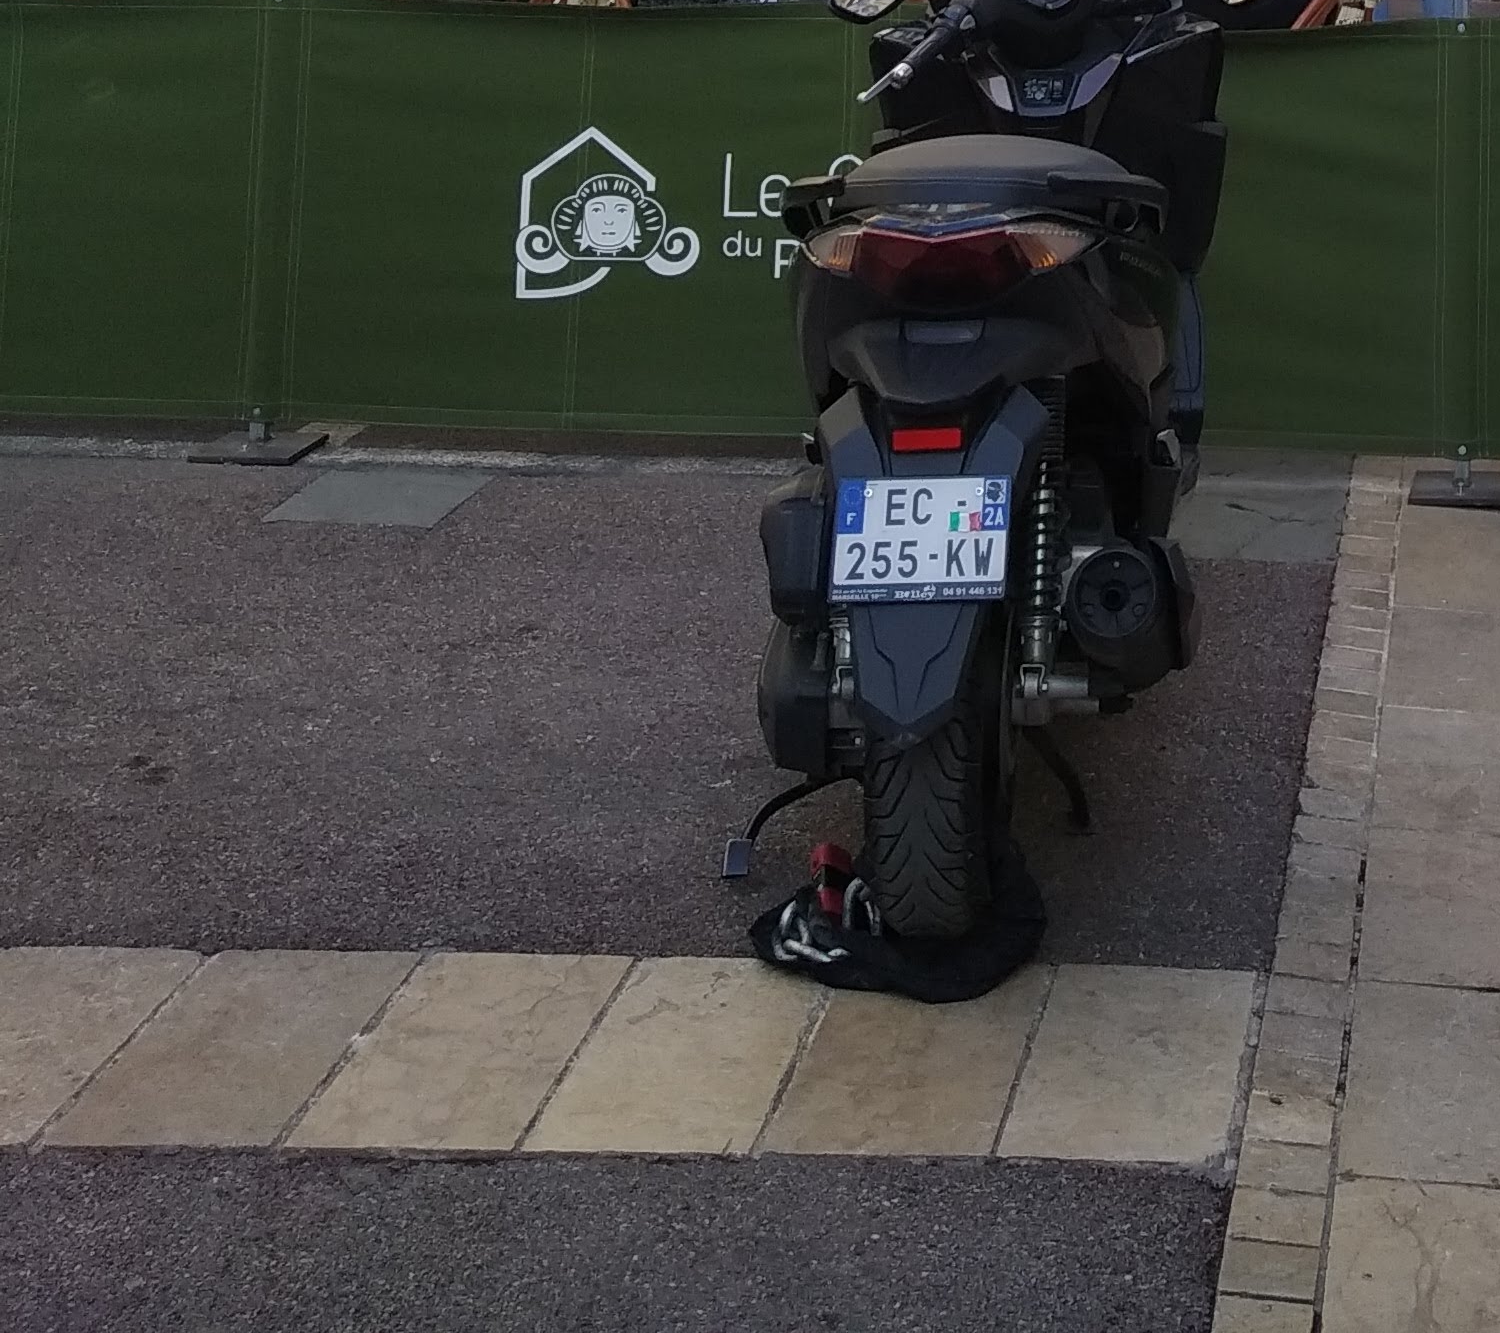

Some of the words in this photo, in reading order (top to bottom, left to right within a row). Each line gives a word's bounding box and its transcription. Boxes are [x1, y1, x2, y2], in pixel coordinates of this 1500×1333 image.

[722, 230, 762, 257] du
[846, 513, 857, 526] F
[984, 506, 1005, 526] 2A
[943, 587, 954, 596] 04
[956, 587, 966, 595] 91
